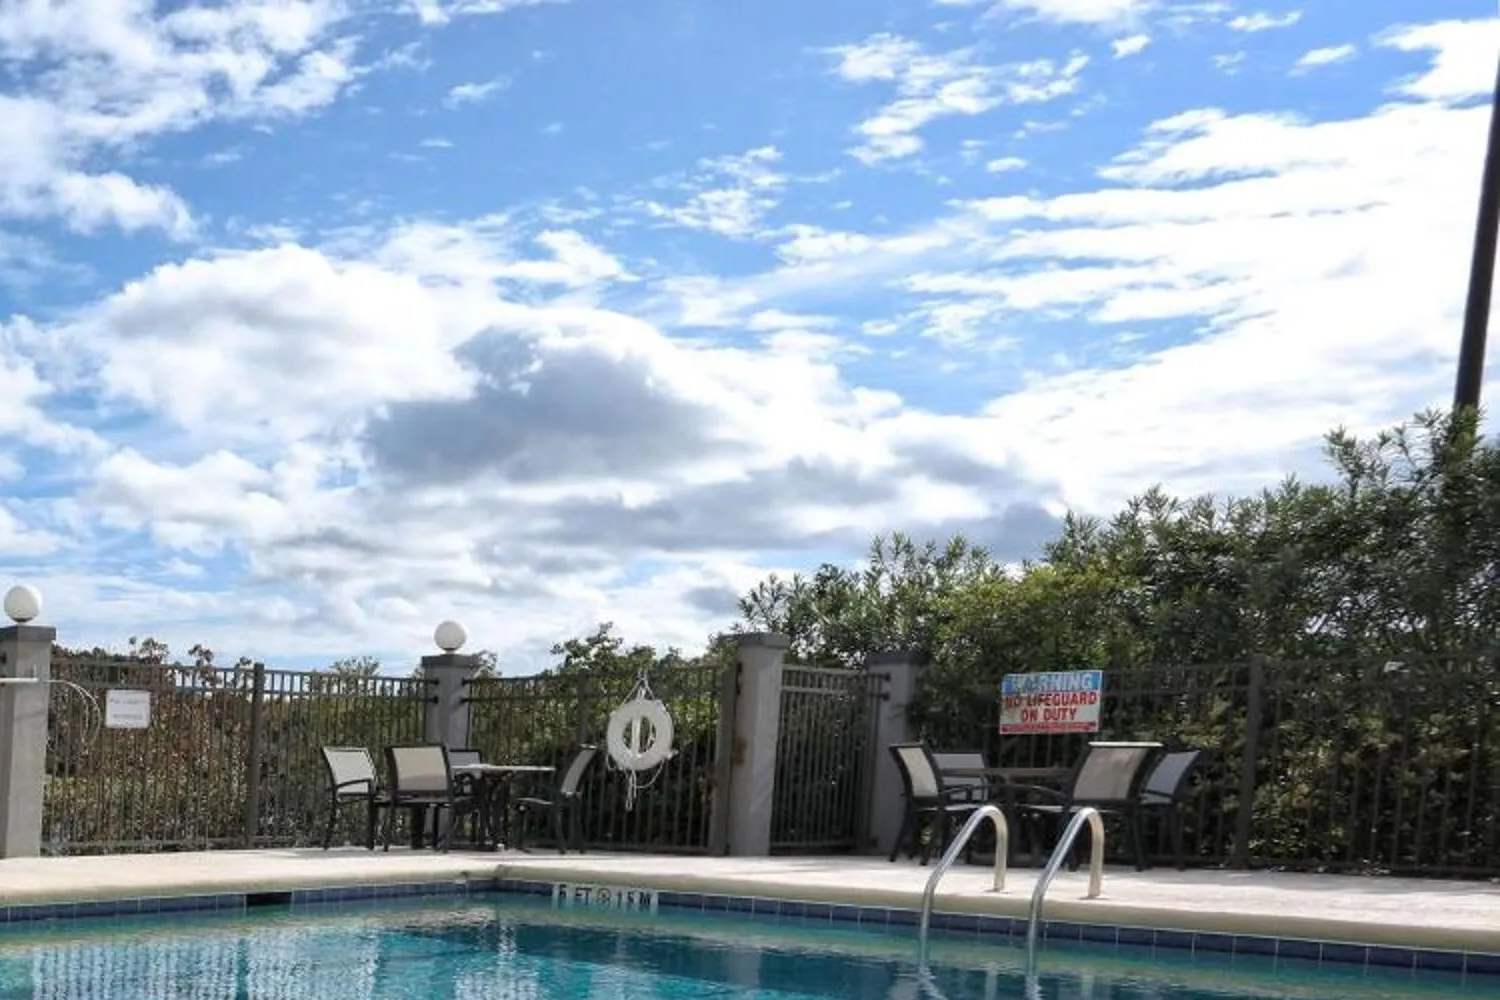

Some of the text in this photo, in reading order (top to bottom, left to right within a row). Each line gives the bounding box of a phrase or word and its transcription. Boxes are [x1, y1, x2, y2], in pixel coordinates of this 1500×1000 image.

[1005, 692, 1097, 708] NO LIFEGUARD
[1021, 708, 1077, 721] ON DUTY
